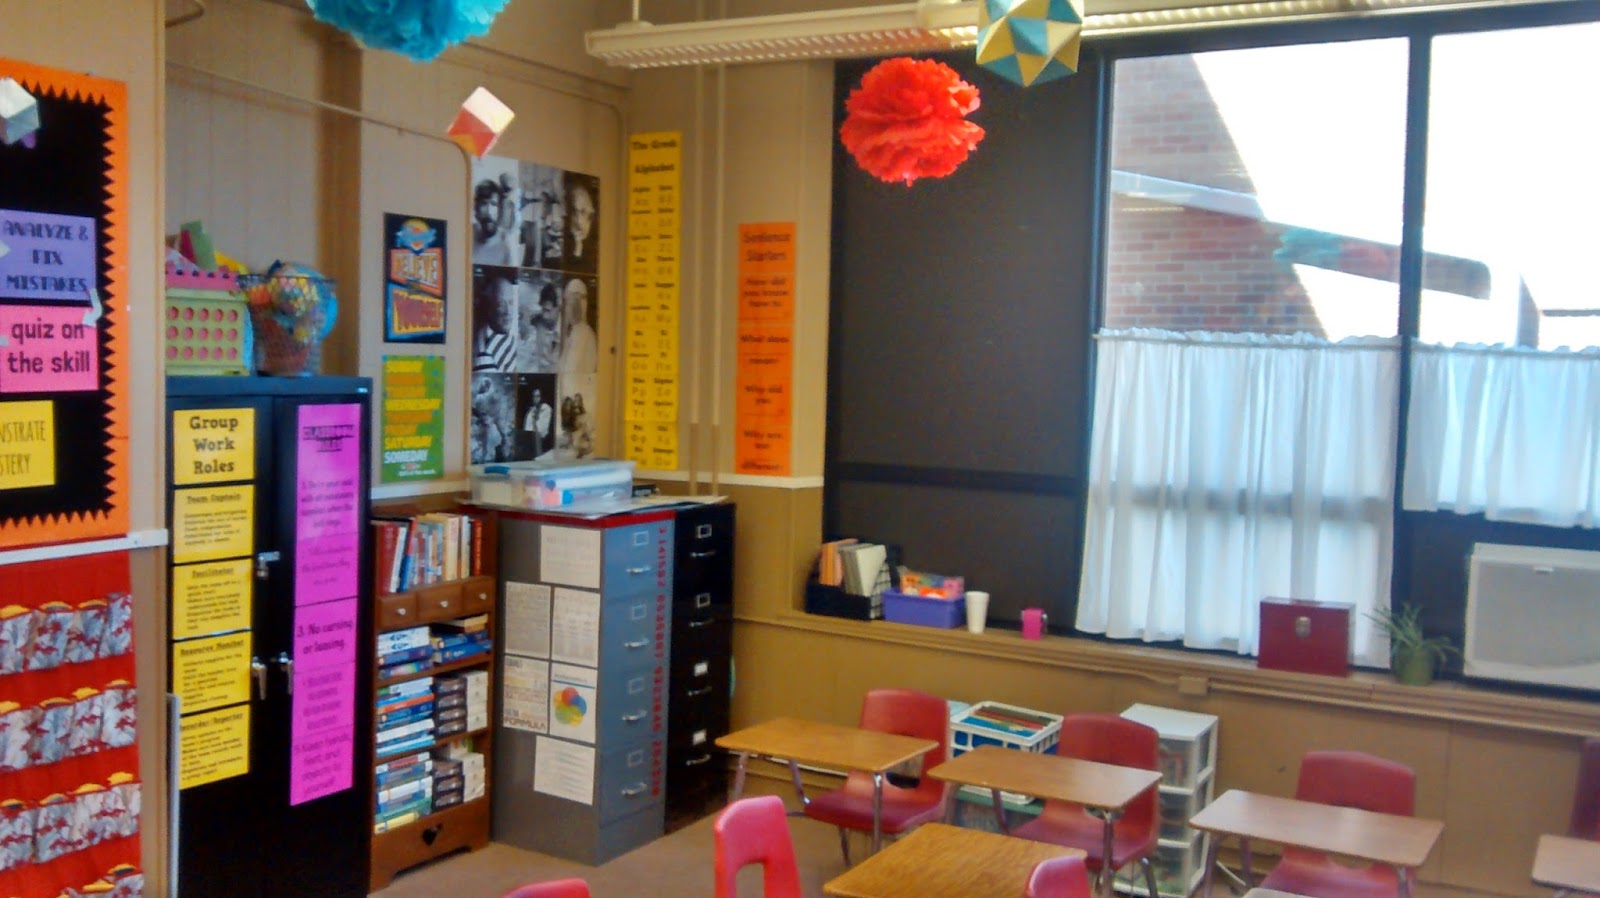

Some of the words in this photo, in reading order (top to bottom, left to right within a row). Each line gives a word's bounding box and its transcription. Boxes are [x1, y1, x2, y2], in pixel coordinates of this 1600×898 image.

[4, 220, 74, 241] ANALYZE
[78, 225, 89, 241] &
[33, 249, 63, 265] FIX
[7, 275, 87, 292] MISTAKES
[11, 317, 55, 346] quiz
[61, 323, 84, 339] on
[7, 351, 43, 373] the
[51, 350, 91, 373] skill
[190, 416, 239, 432] Group
[193, 436, 236, 452] Work
[384, 449, 429, 464] SOMEDAY
[193, 459, 235, 475] Roles
